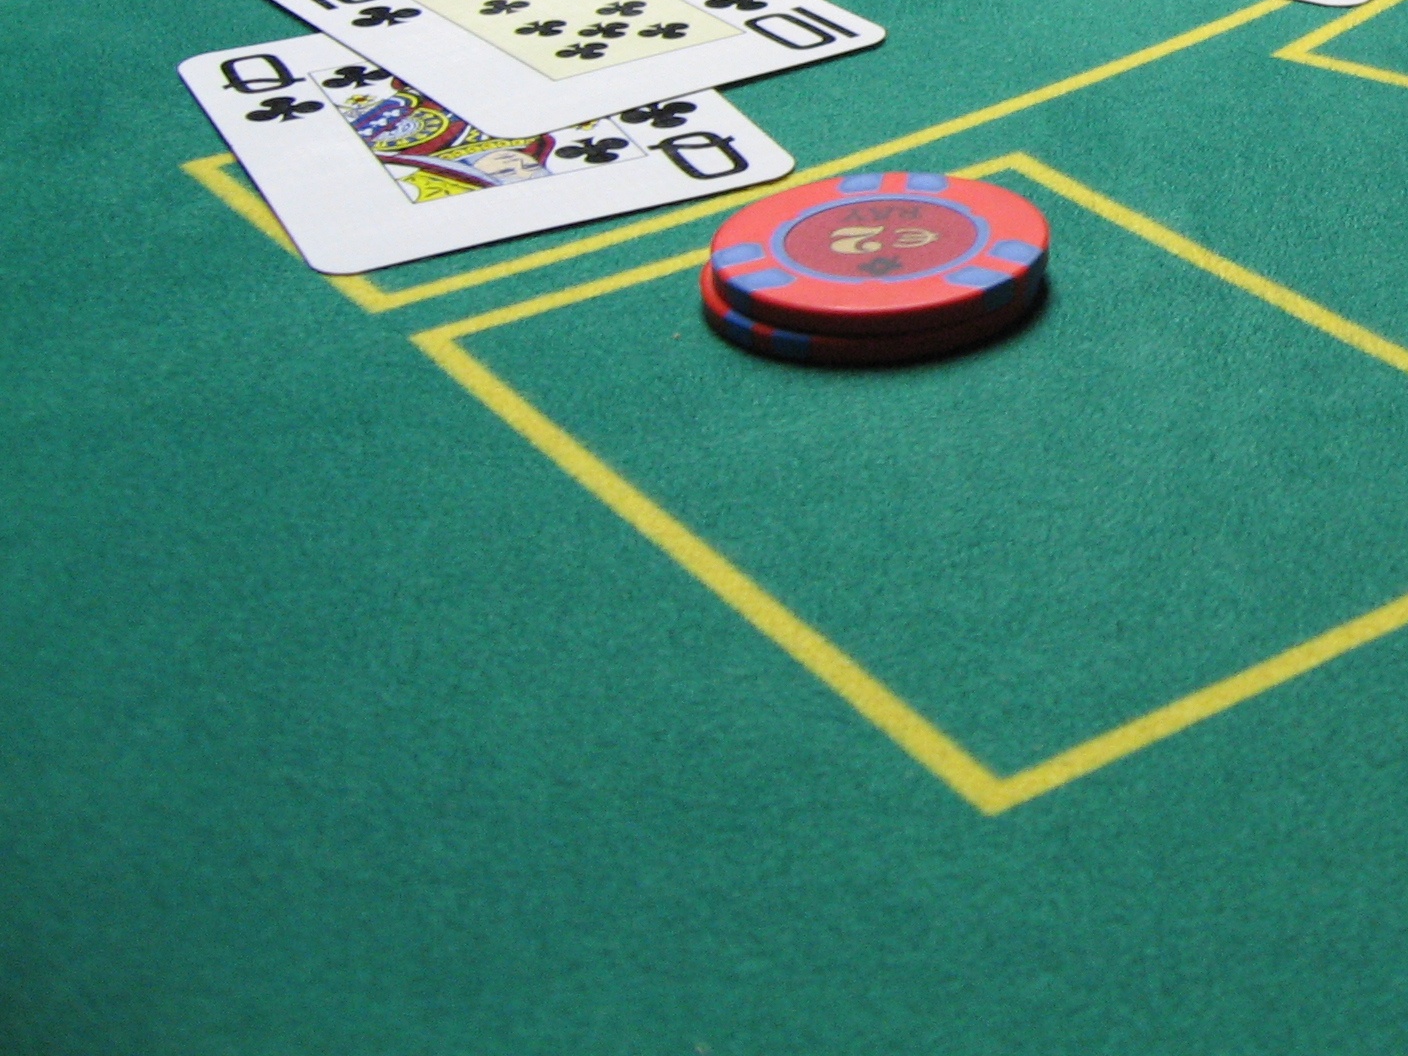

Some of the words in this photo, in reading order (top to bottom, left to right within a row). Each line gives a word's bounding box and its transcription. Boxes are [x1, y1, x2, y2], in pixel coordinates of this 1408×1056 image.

[744, 5, 862, 51] 10
[220, 53, 307, 96] Q
[647, 131, 751, 181] Q
